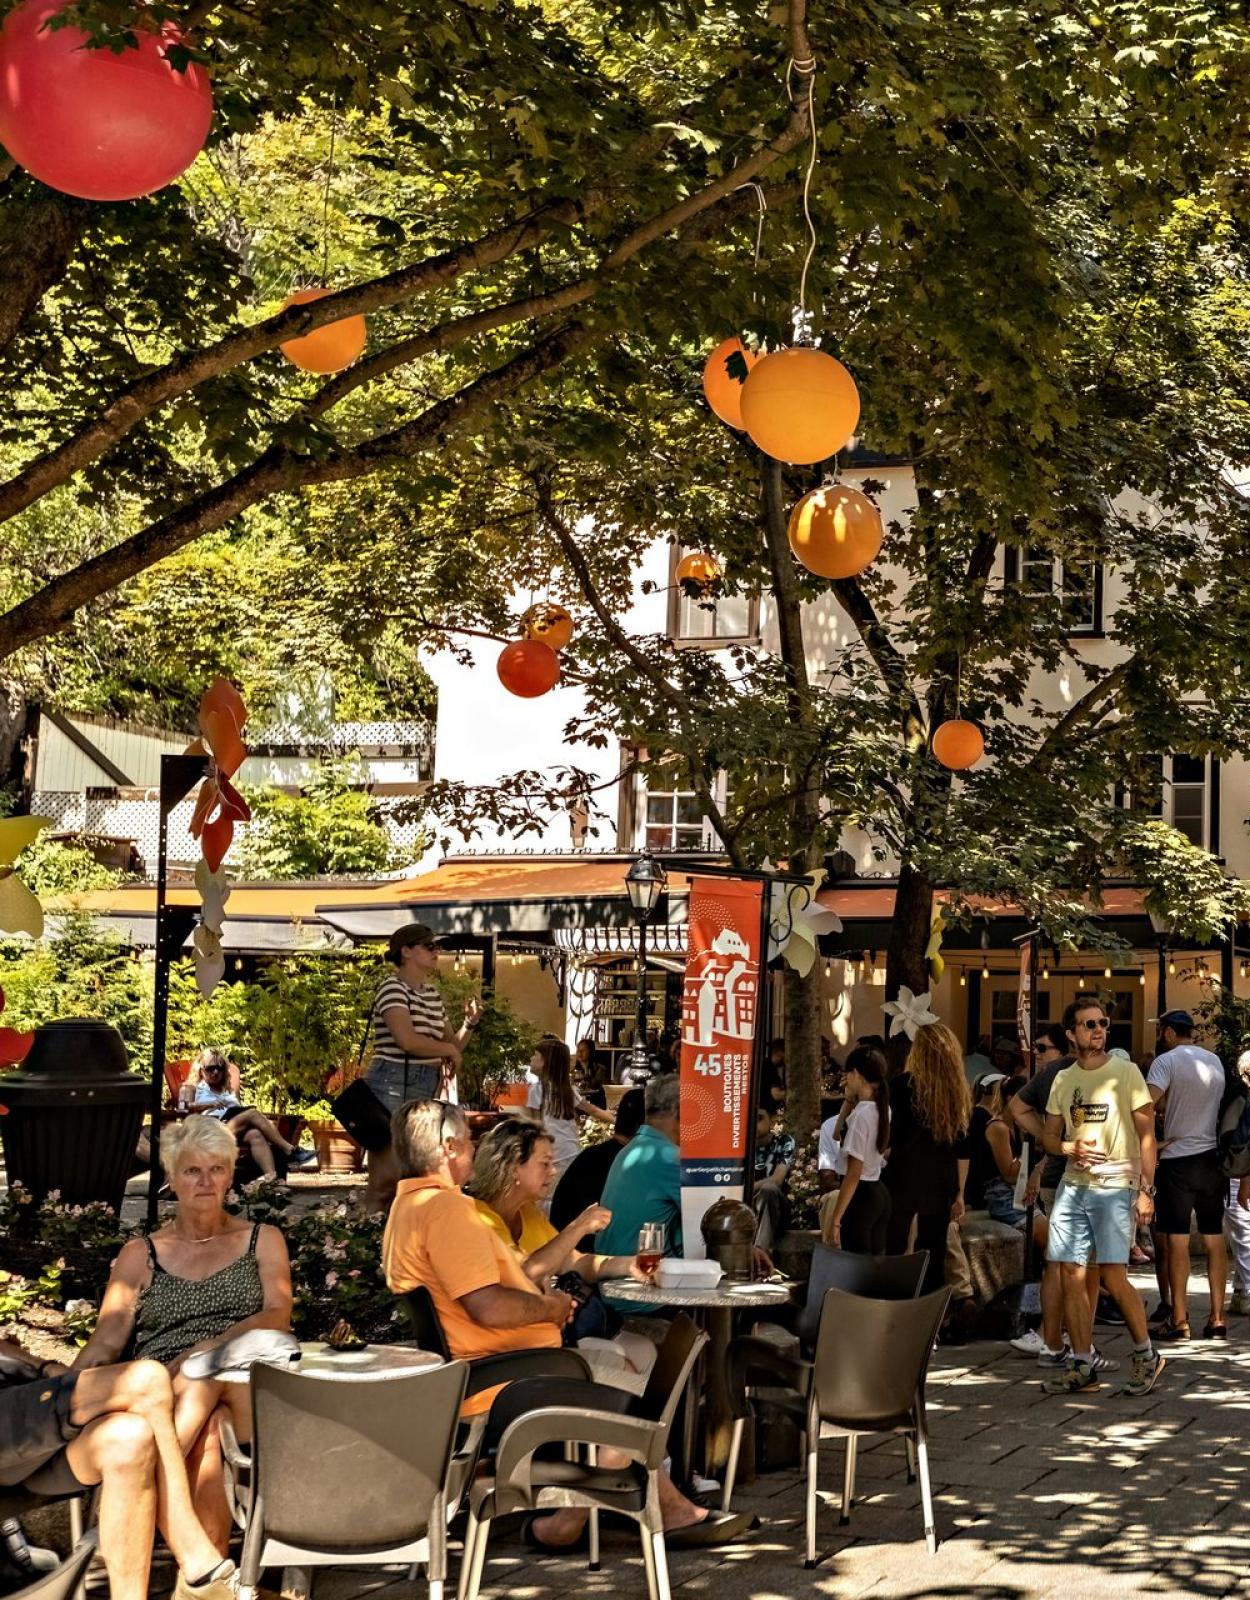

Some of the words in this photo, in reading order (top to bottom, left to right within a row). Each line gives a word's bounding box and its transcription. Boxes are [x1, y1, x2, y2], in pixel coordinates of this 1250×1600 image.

[693, 1053, 721, 1076] 45
[723, 1053, 732, 1112] BOUTIQUES
[741, 1054, 749, 1095] RESTOS
[732, 1053, 742, 1148] DIVERTISSEMENTS
